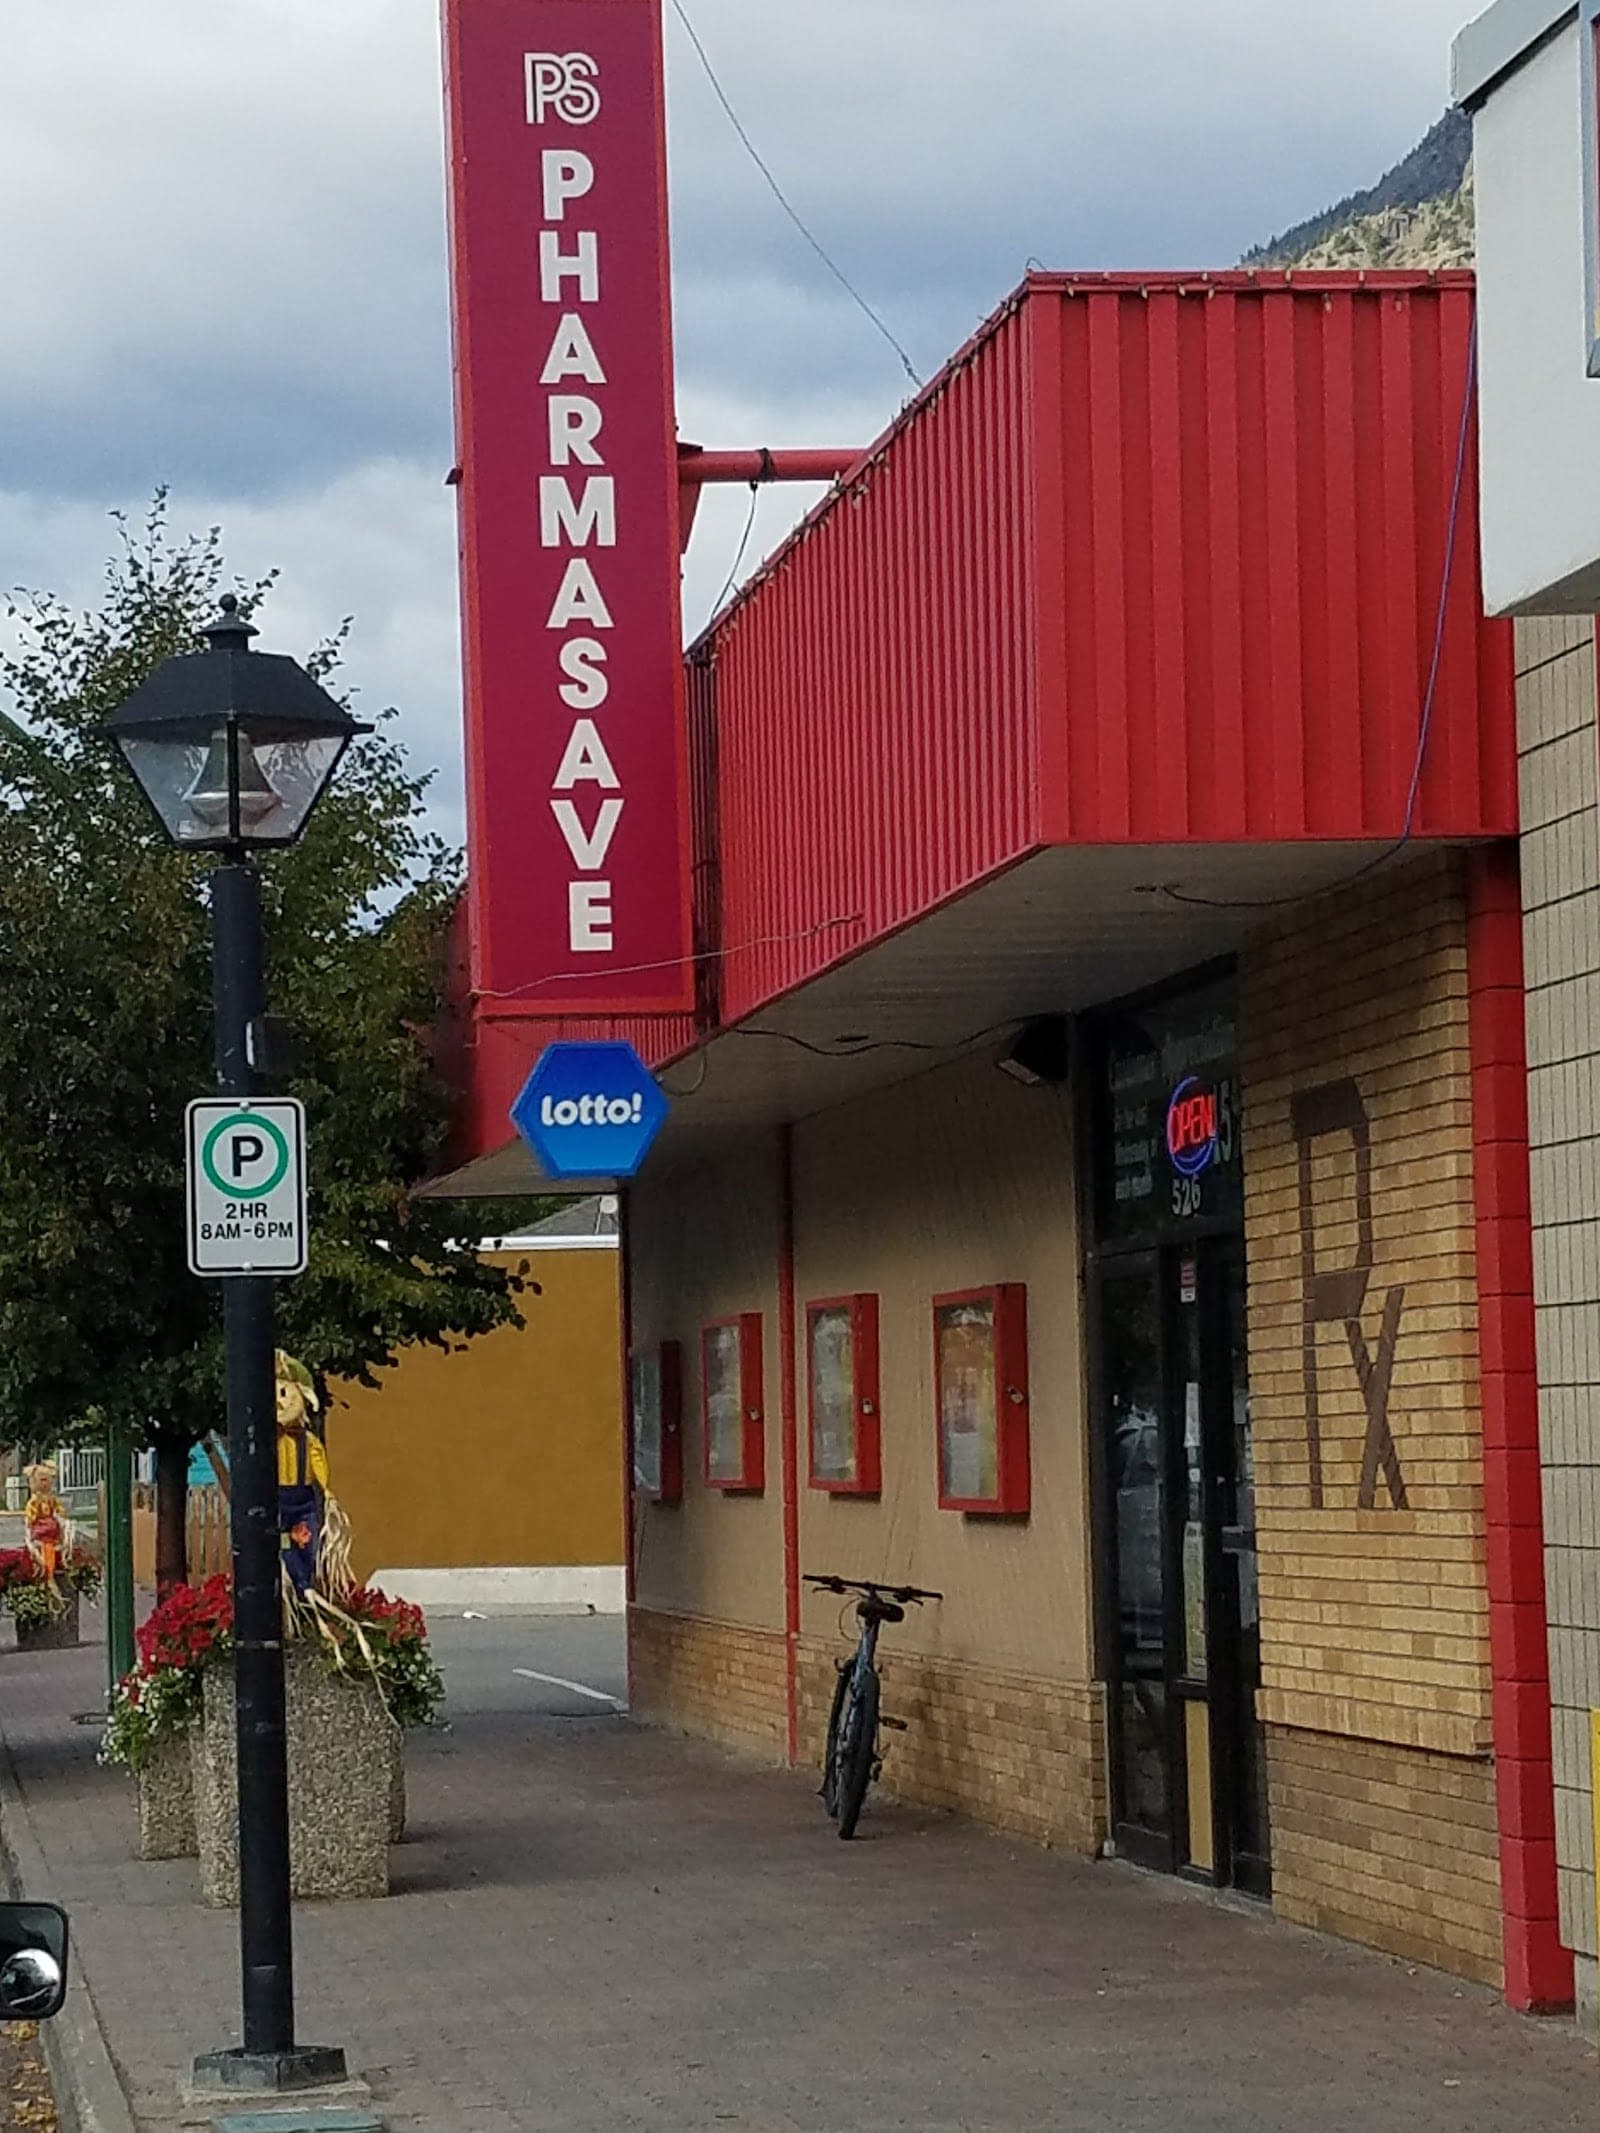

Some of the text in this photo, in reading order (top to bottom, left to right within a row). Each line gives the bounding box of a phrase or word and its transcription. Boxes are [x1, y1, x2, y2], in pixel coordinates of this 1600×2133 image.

[524, 53, 599, 125] PS
[539, 150, 625, 951] PHARMASAVE
[541, 1092, 643, 1126] lotto!
[1169, 1094, 1216, 1154] OPEN
[231, 1136, 264, 1177] P
[1171, 1174, 1201, 1217] 526
